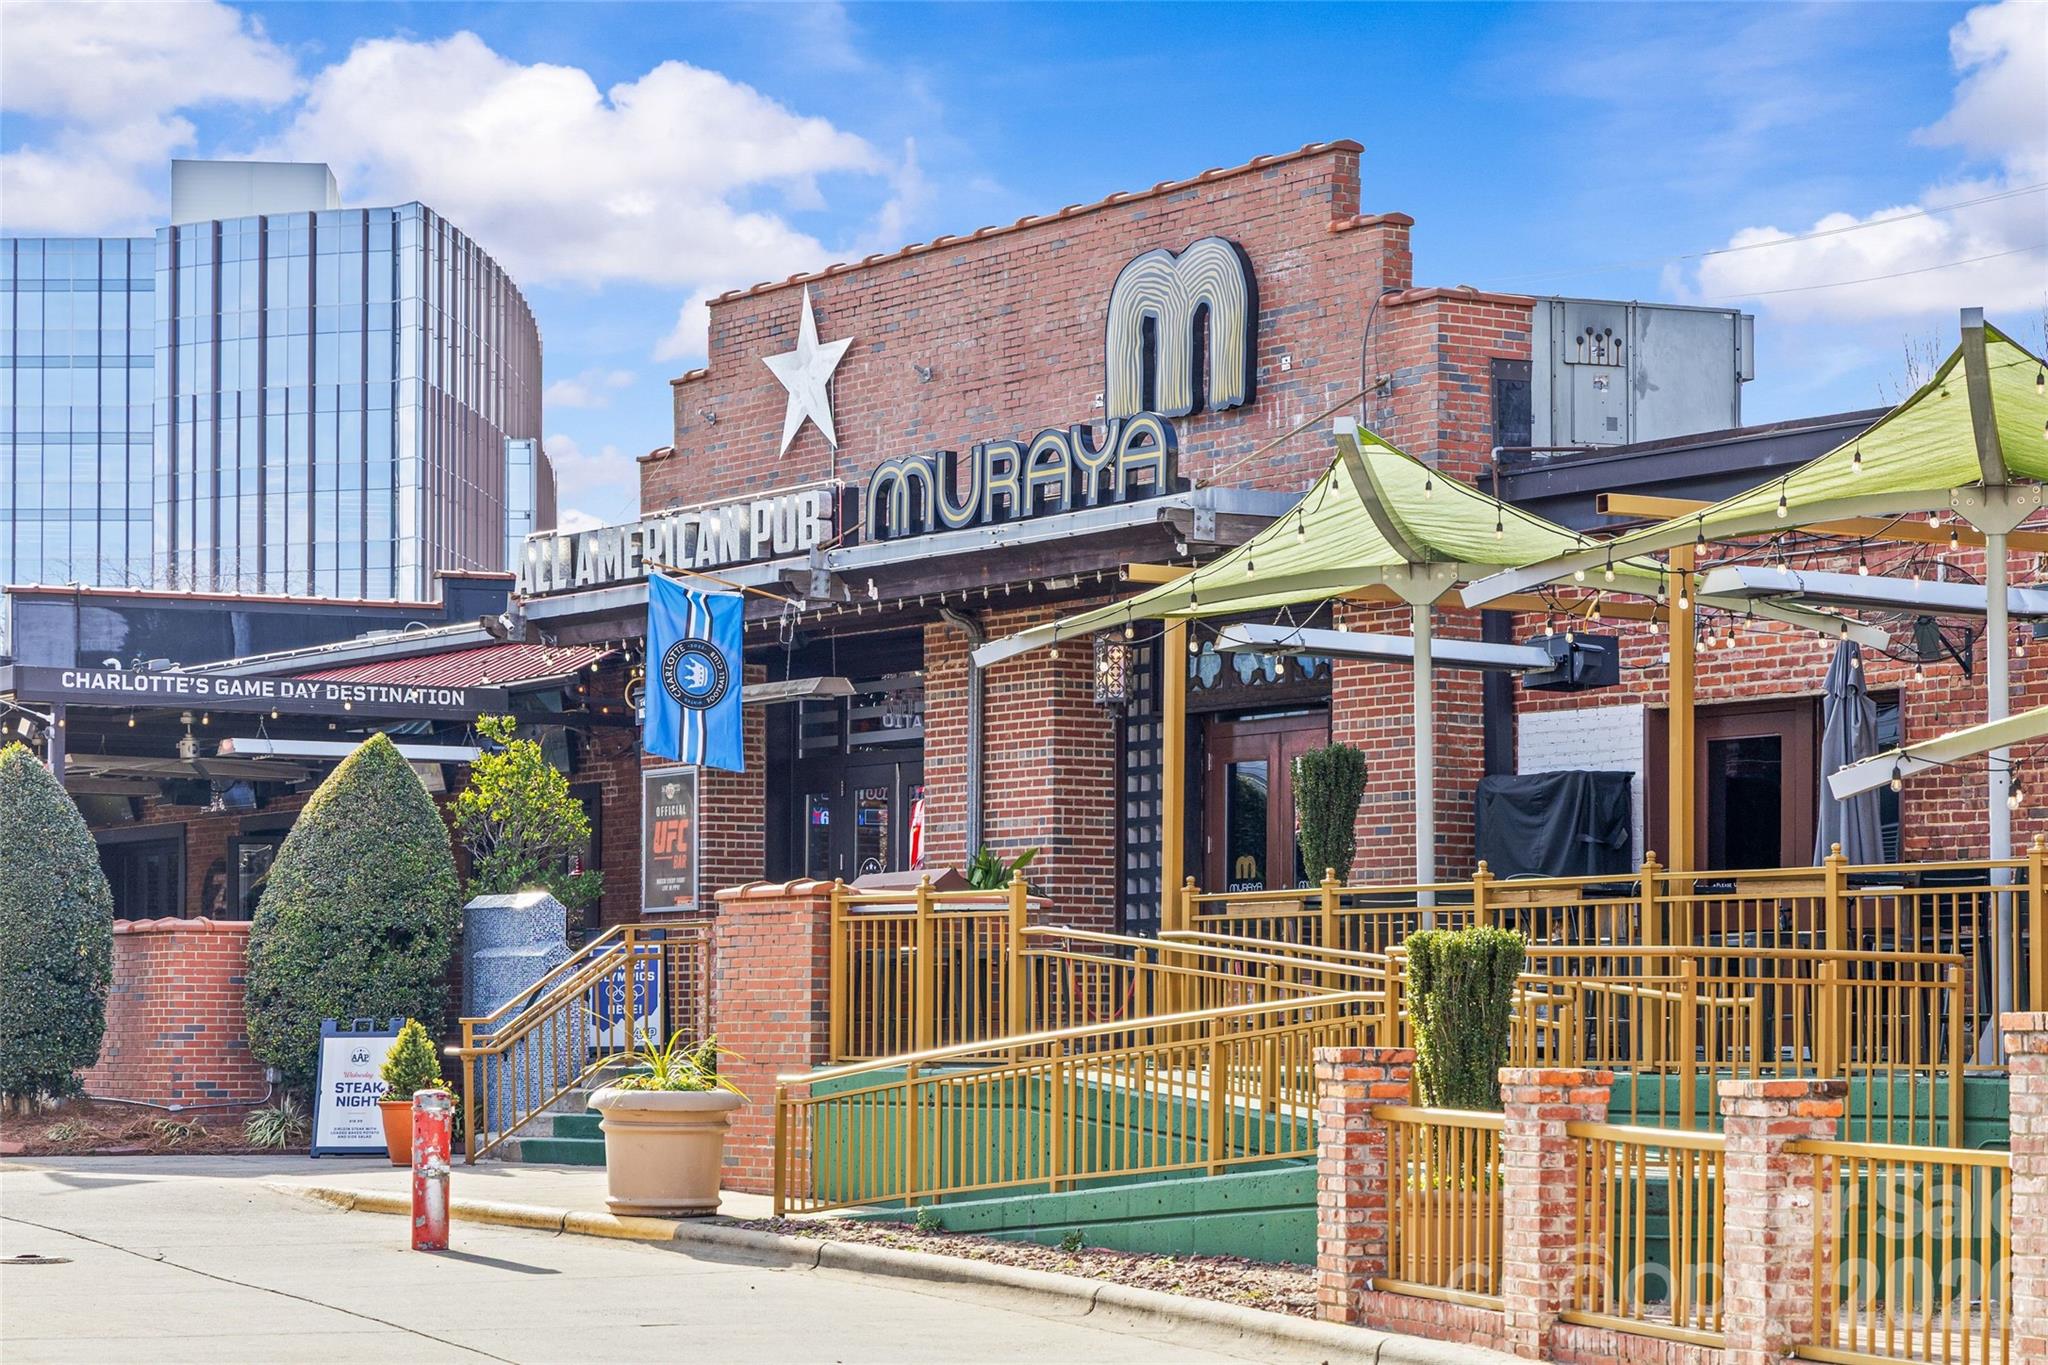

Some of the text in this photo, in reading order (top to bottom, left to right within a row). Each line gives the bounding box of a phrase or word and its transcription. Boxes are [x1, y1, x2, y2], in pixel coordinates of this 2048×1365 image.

[865, 412, 1174, 541] MURAYA
[515, 490, 832, 594] ALL AMERICAN PUB
[664, 643, 686, 698] CHARLOTTE
[705, 651, 725, 704] FOOTBALL CLUB
[61, 671, 466, 706] CHARLOTTE'S GAME DAY DESTINATION
[655, 803, 687, 818] OFFICIAL
[652, 818, 689, 854] UFC
[671, 854, 688, 869] BAR
[1229, 882, 1263, 892] MURAYA
[600, 971, 655, 983] LYMICS
[607, 1004, 643, 1015] HEE!
[335, 1082, 383, 1093] STEAK
[336, 1096, 381, 1107] NIGHT
